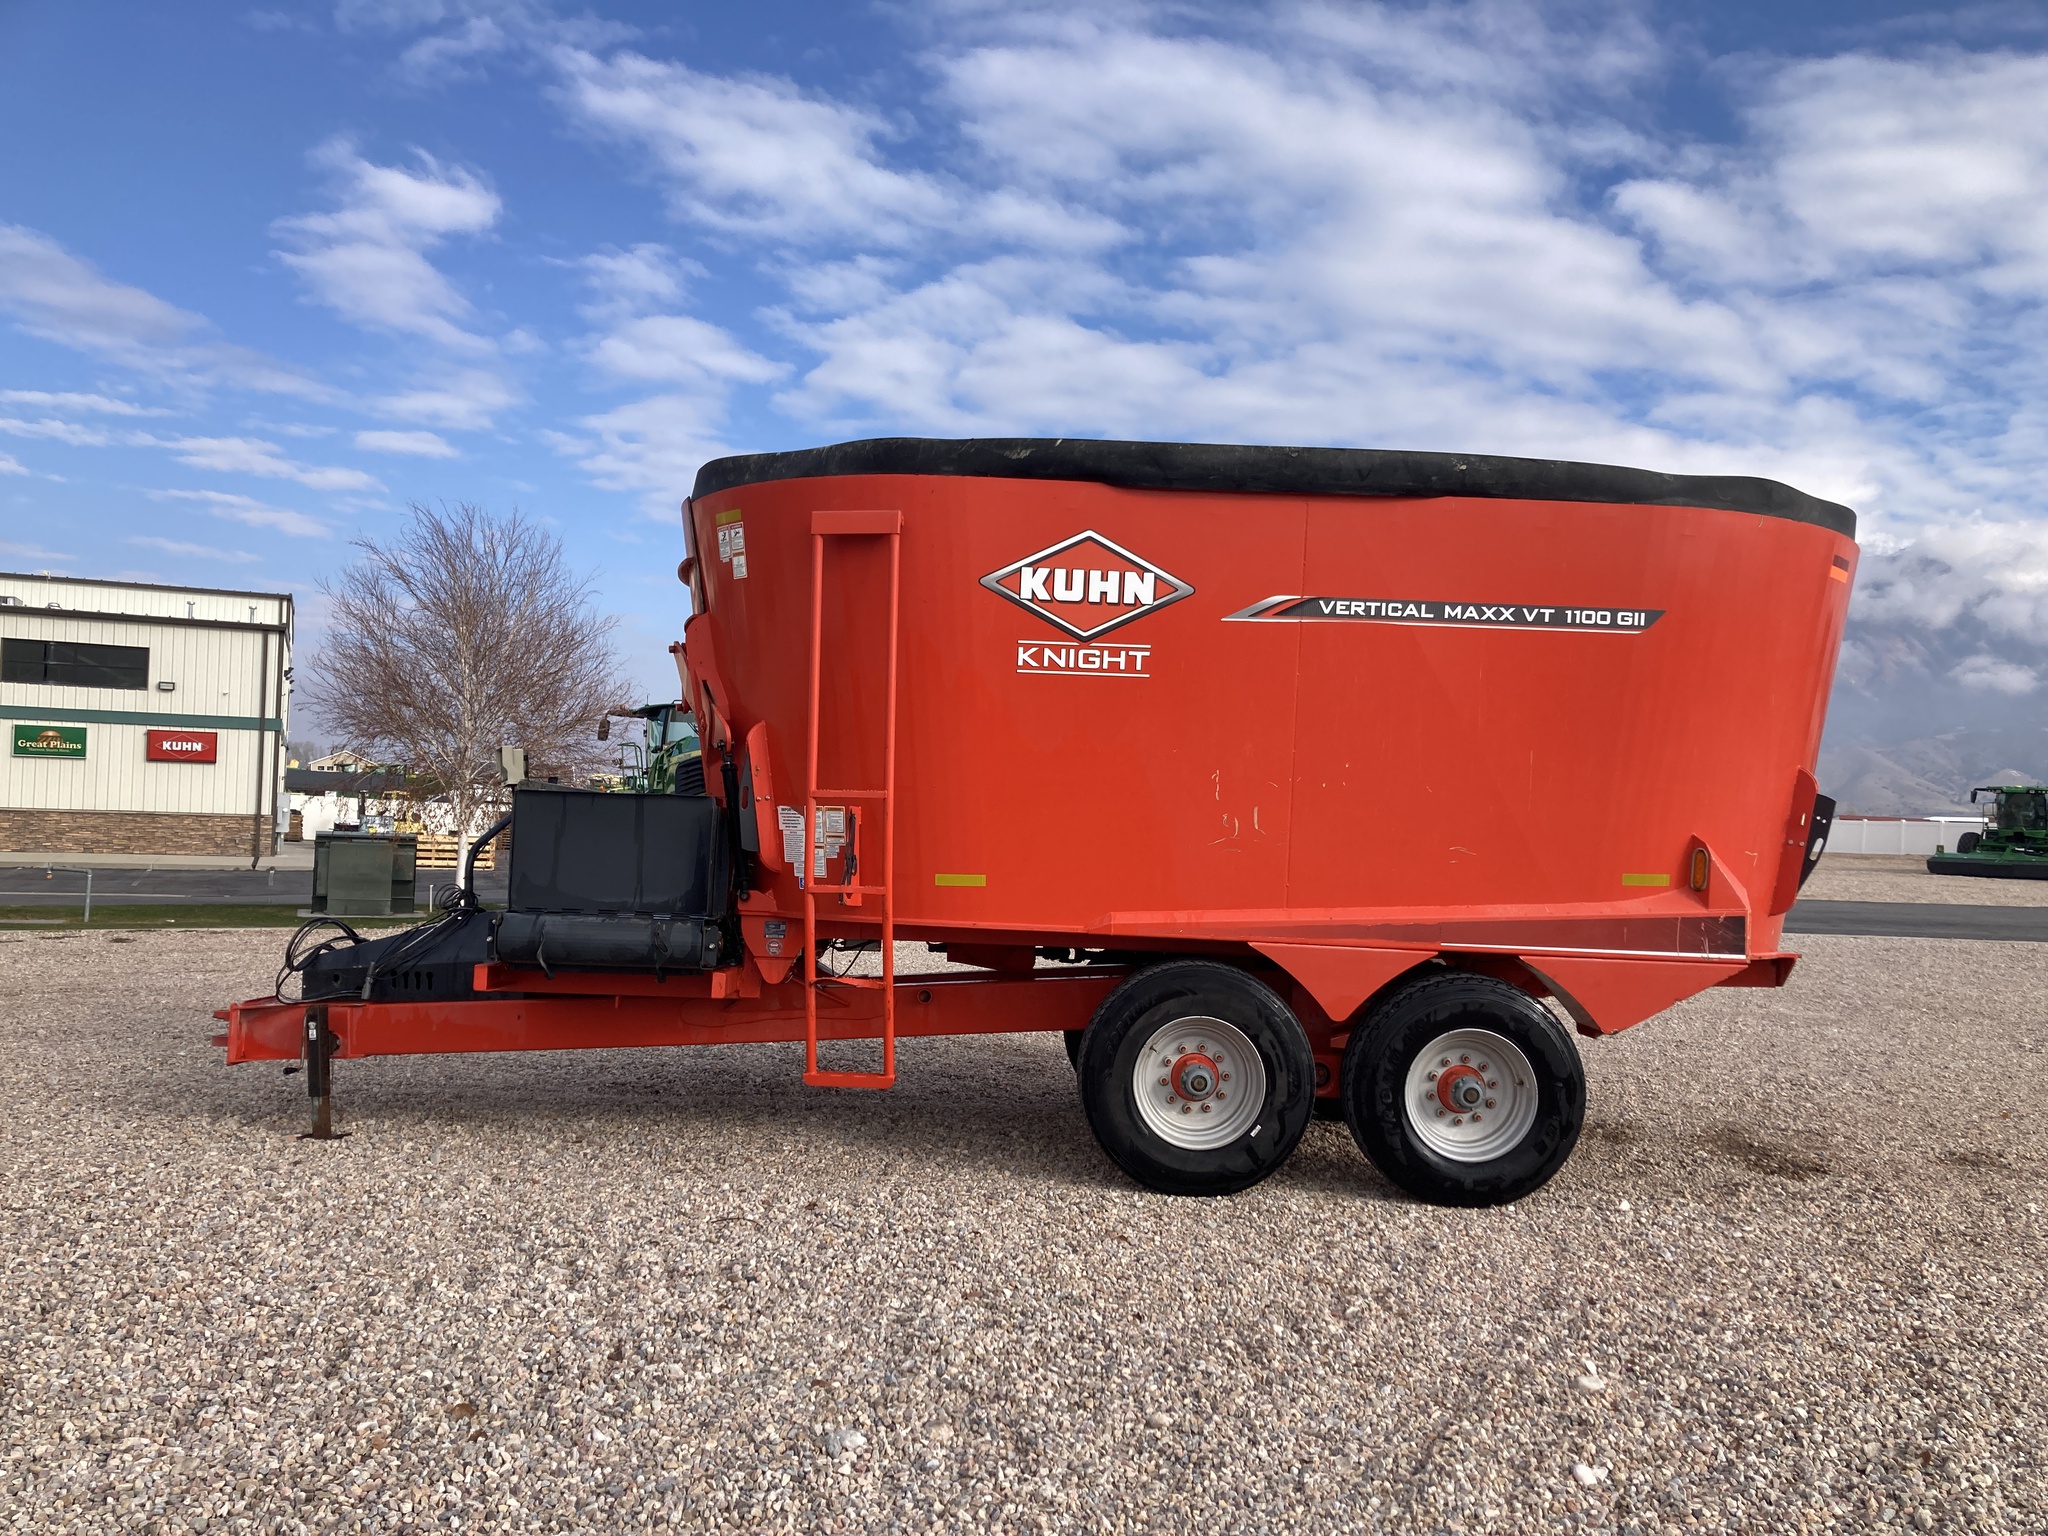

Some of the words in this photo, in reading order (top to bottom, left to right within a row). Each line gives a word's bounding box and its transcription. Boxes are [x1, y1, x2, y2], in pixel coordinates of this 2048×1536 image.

[1020, 566, 1155, 605] KUHN
[1318, 600, 1434, 619] VERTICAL
[1444, 606, 1515, 622] MAXX
[1523, 608, 1555, 622] VT
[1564, 609, 1611, 625] 1100
[1617, 611, 1646, 627] GII
[1017, 646, 1150, 671] KNIGHT
[18, 739, 46, 748] Great
[50, 740, 82, 749] Plains
[163, 740, 202, 752] KUHN
